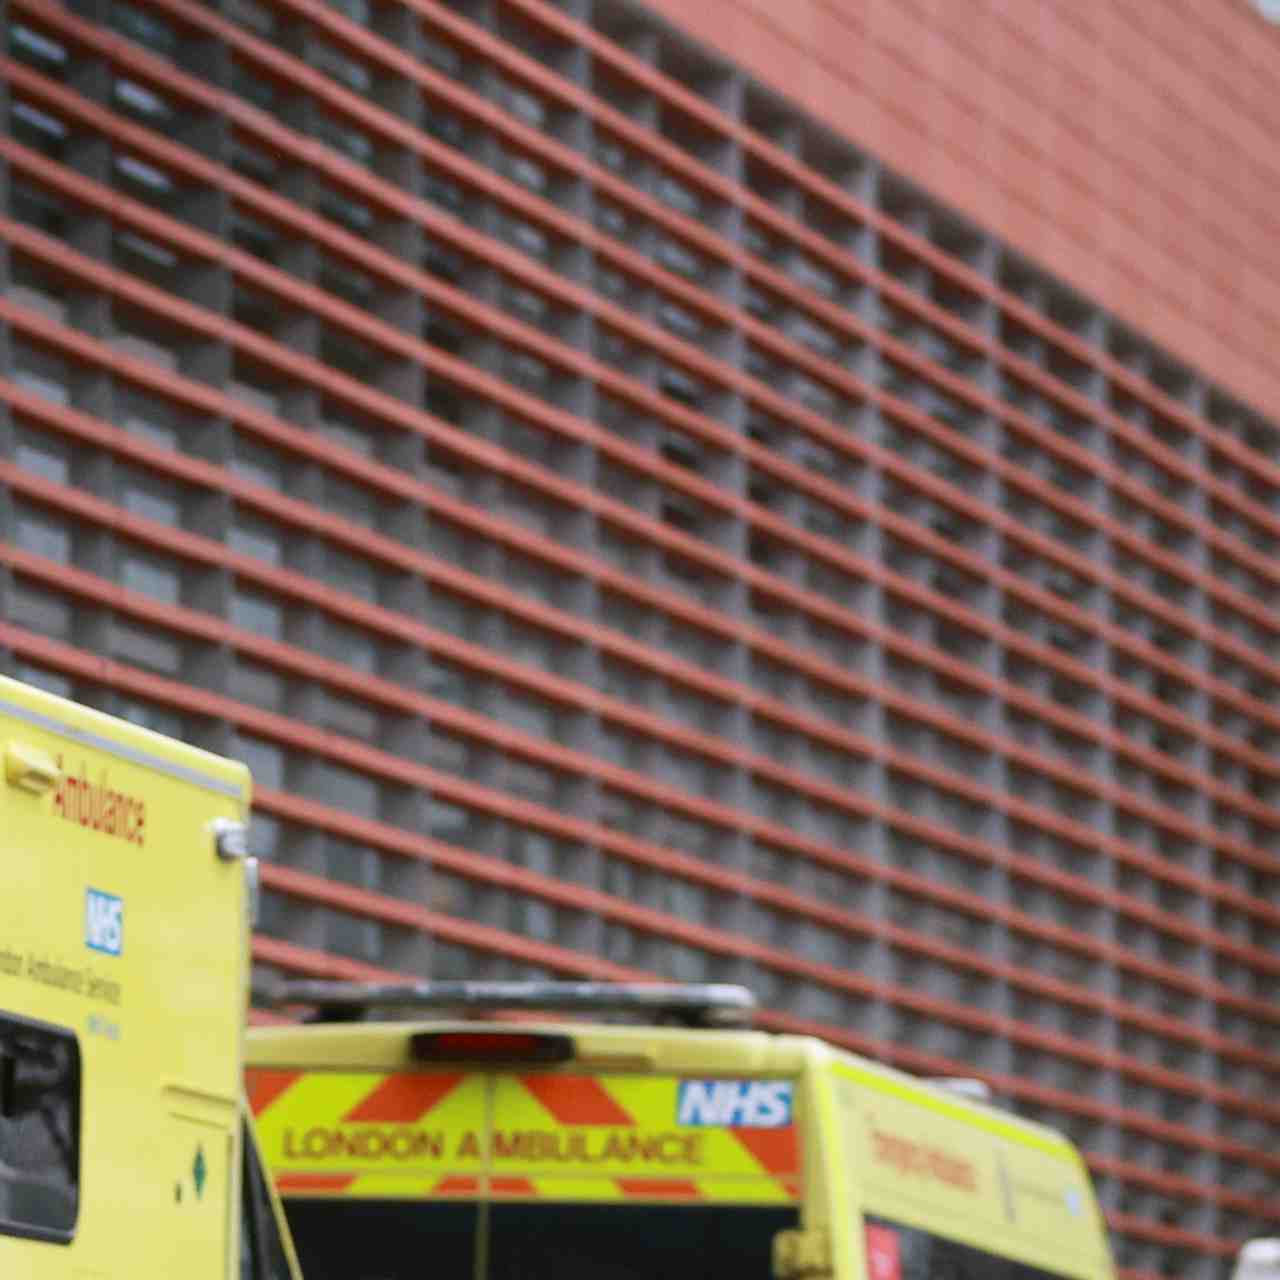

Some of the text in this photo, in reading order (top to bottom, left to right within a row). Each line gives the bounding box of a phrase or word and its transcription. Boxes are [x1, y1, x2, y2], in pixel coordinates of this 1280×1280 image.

[53, 752, 146, 846] Ambulance
[85, 891, 123, 953] NHS
[680, 1081, 792, 1126] NHS
[282, 1127, 705, 1166] LONDON AMBULANCE
